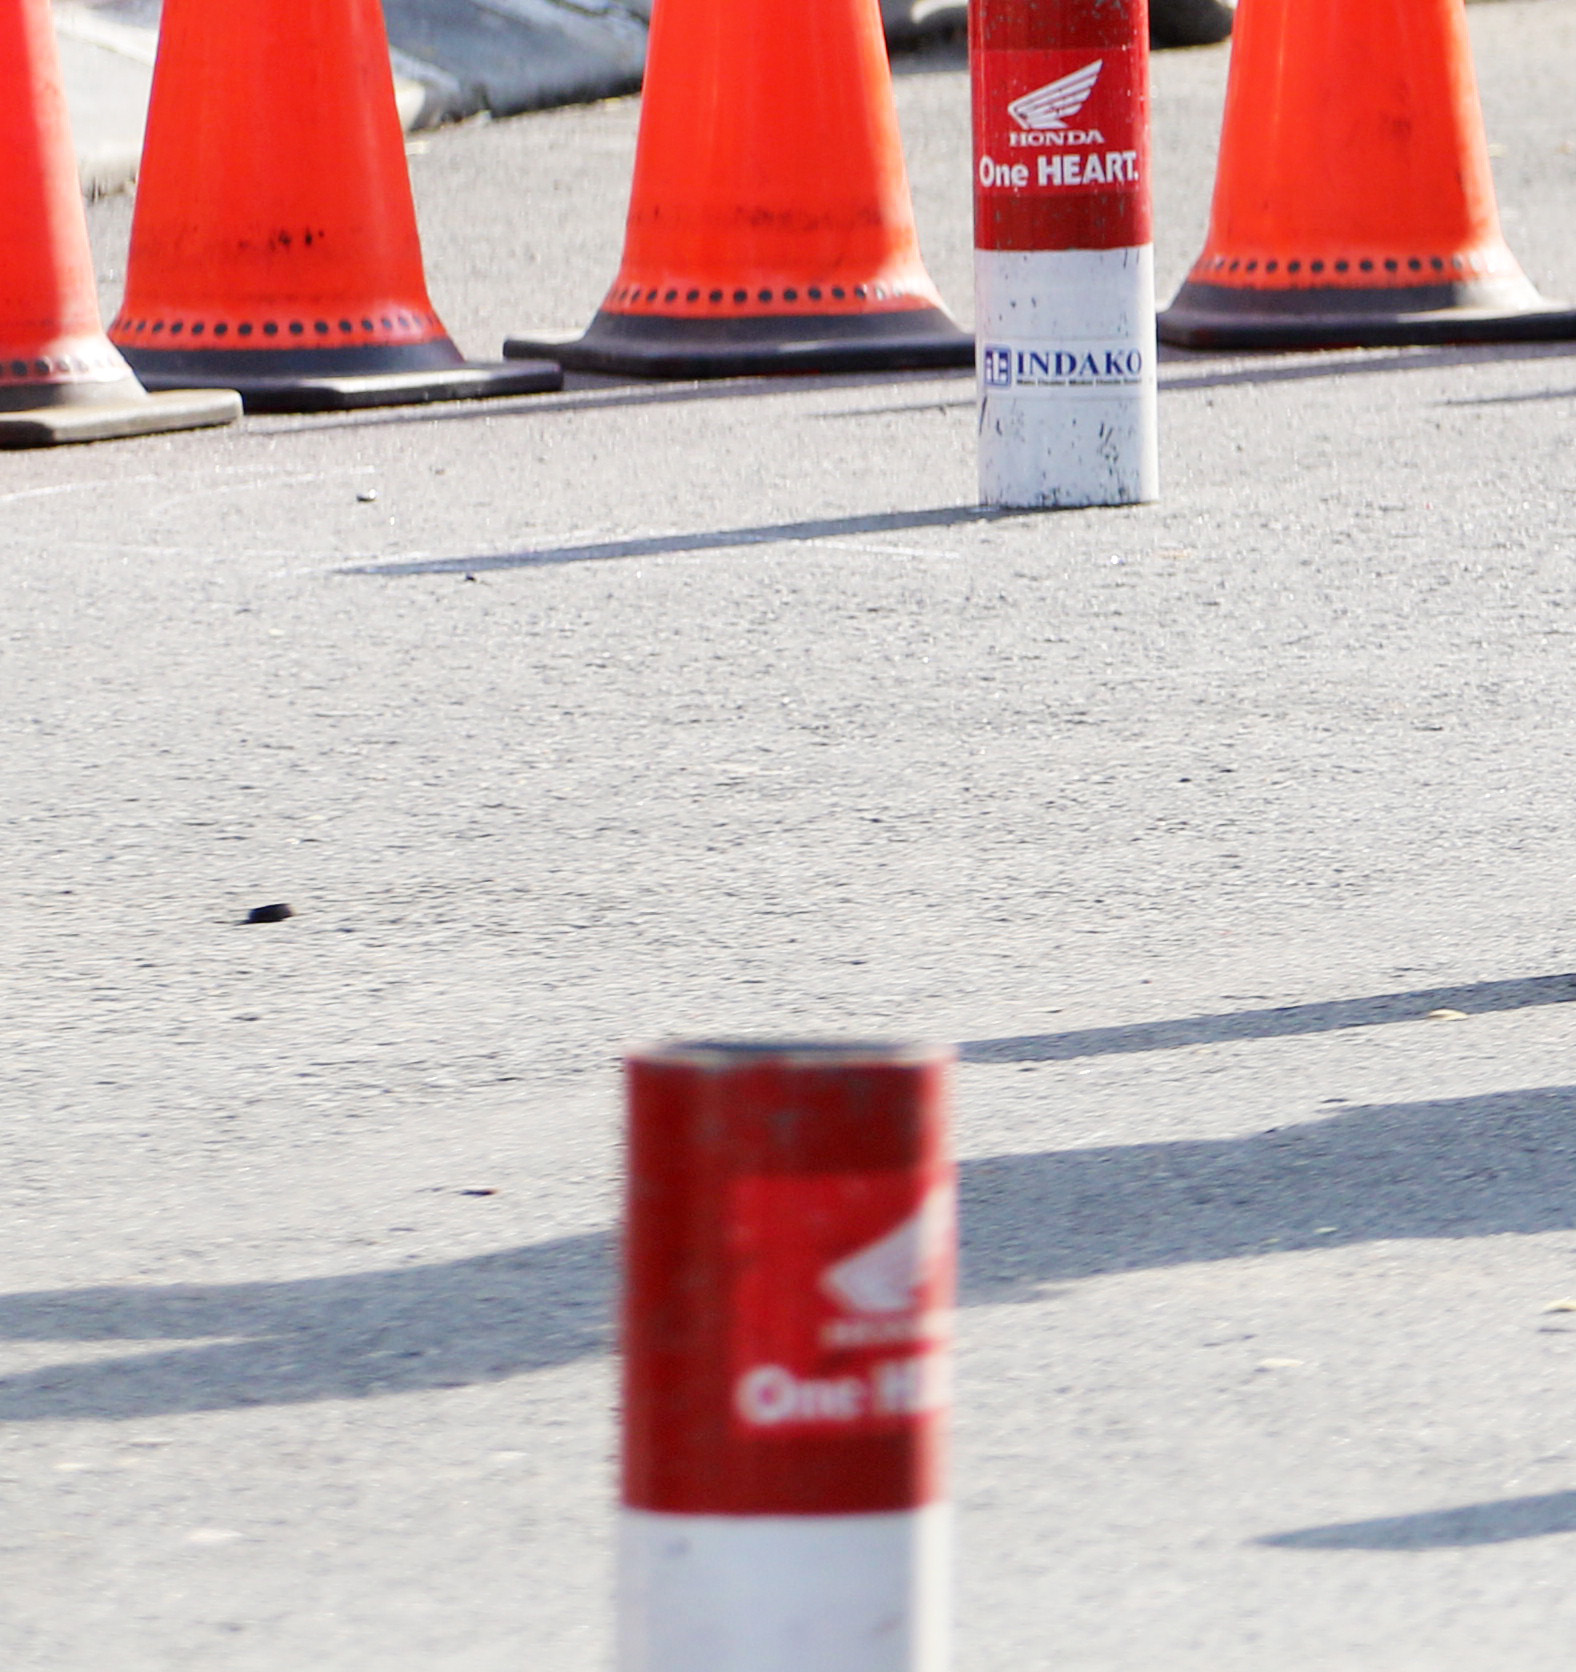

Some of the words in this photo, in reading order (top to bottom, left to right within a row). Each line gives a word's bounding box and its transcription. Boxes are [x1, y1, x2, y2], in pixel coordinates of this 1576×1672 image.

[1009, 129, 1106, 147] HONDA
[979, 155, 1029, 188] One
[1016, 348, 1143, 376] INDAKO
